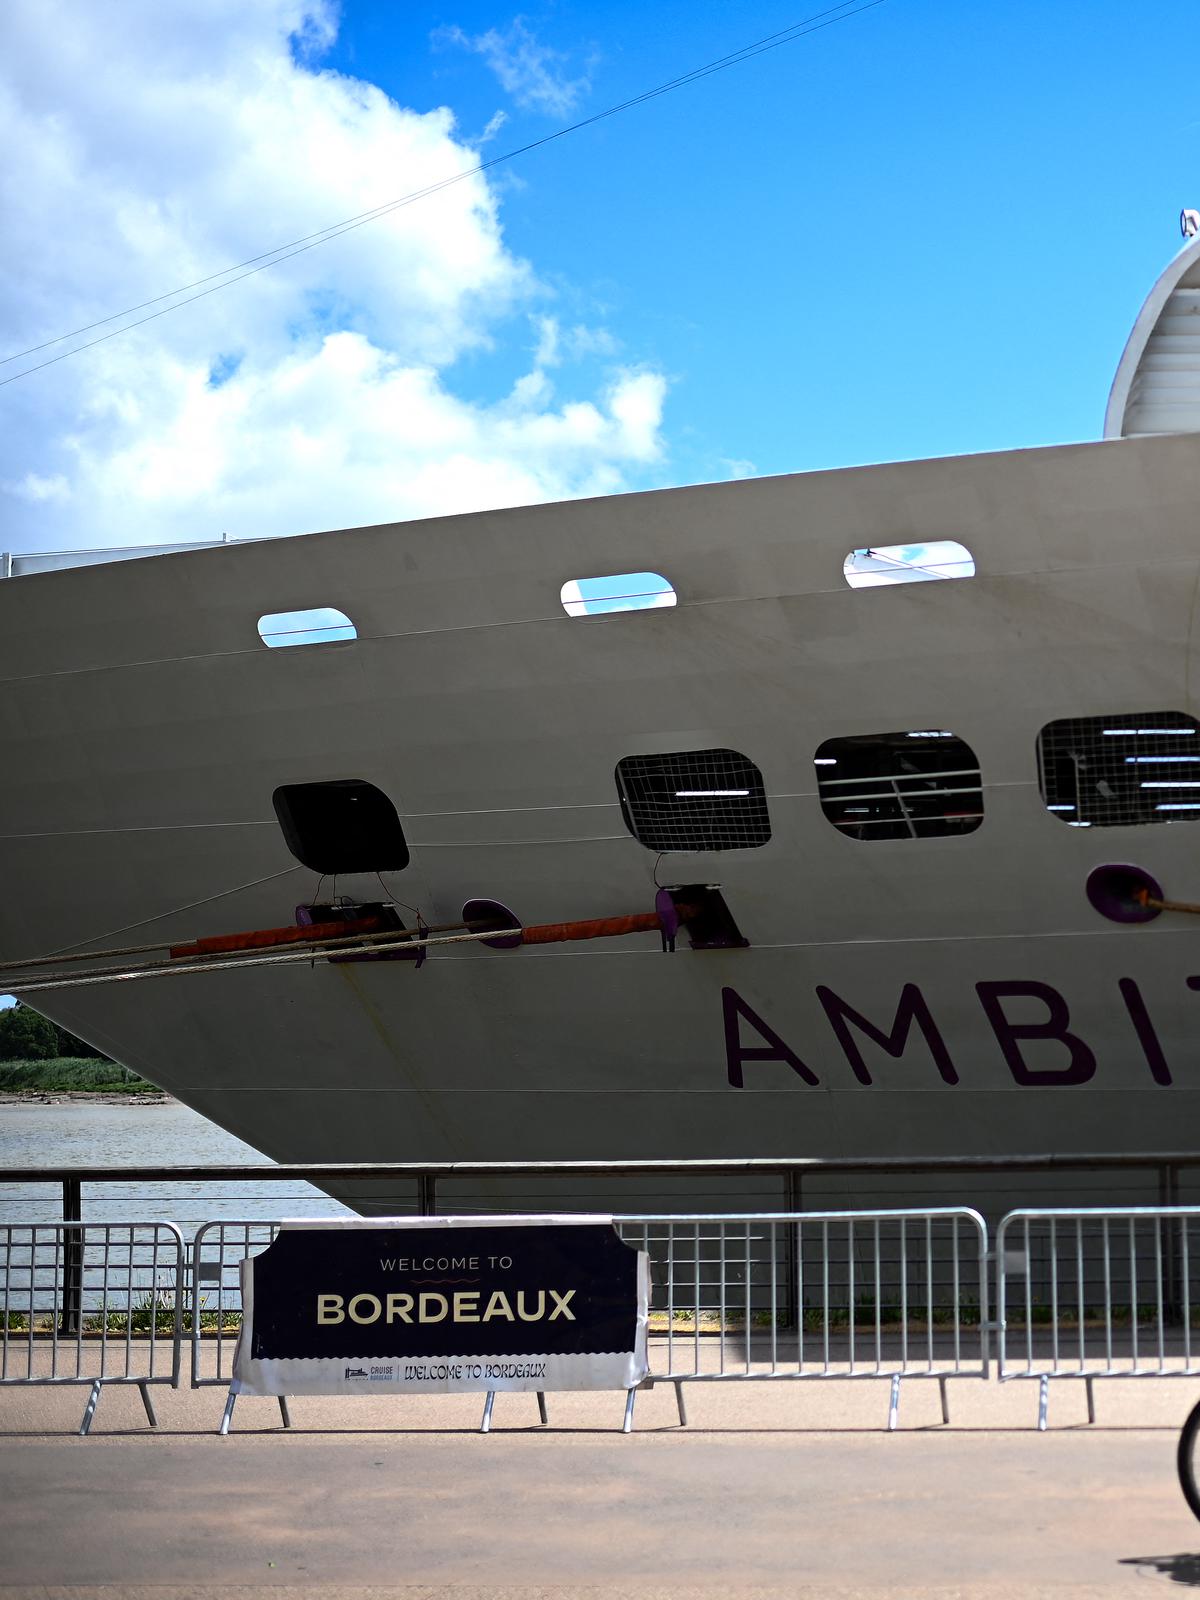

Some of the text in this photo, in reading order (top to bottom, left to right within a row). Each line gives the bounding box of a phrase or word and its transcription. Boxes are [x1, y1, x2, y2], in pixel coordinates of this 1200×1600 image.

[380, 1256, 513, 1271] WELCOME TO
[317, 1290, 577, 1325] BORDEAUX
[370, 1366, 393, 1375] CRUISE
[404, 1365, 463, 1380] WELCOME
[466, 1364, 482, 1379] TO
[484, 1363, 546, 1379] BORDEAUX
